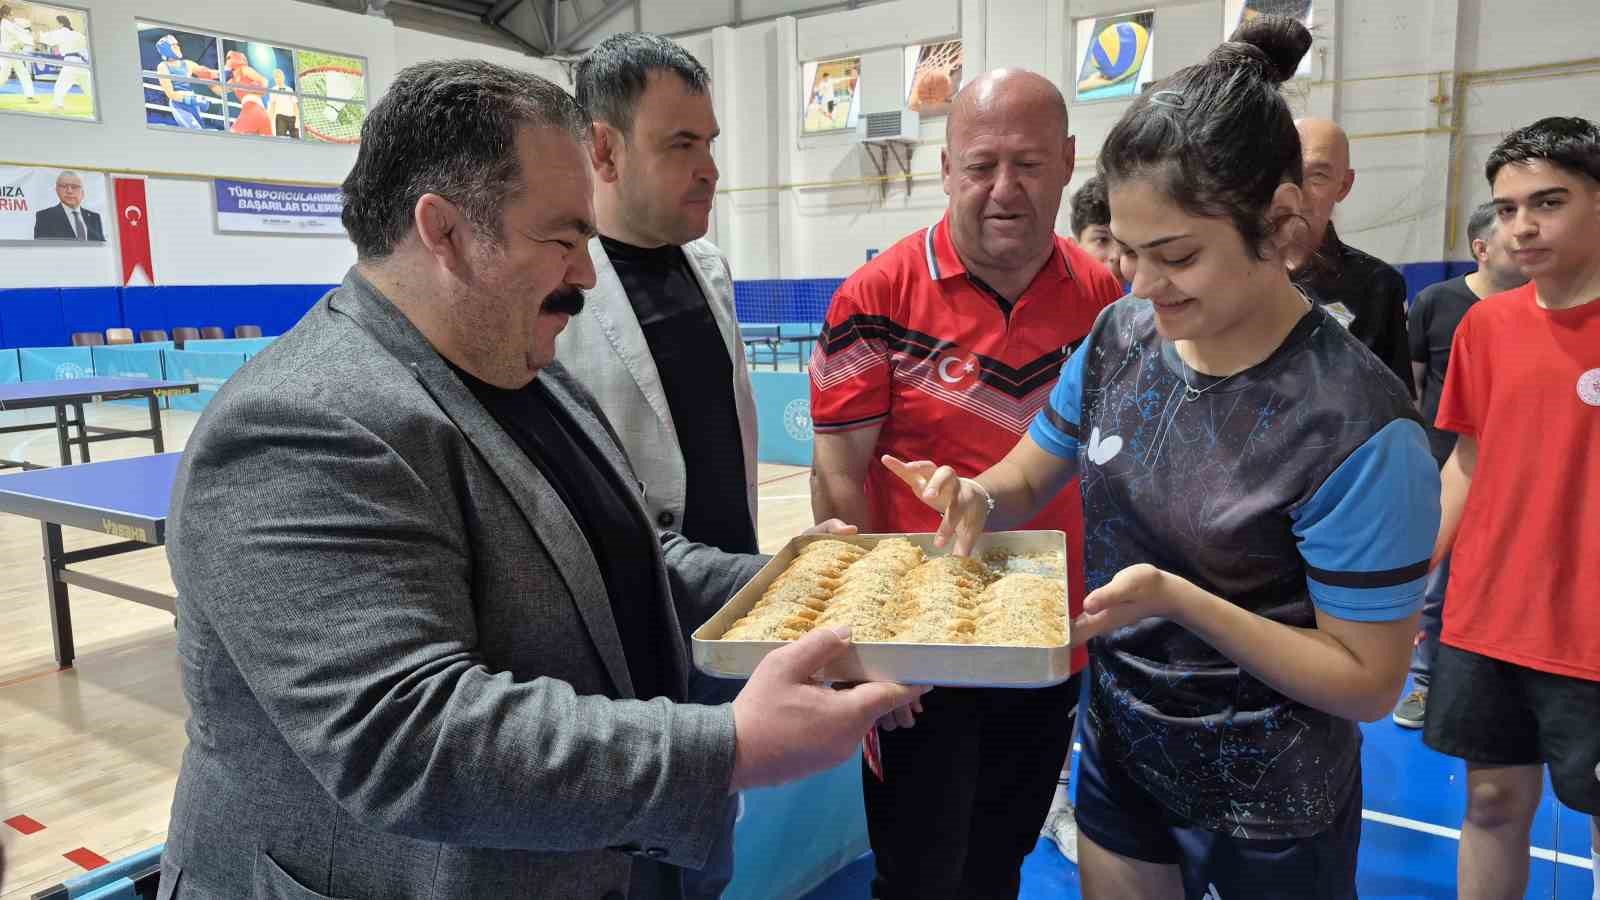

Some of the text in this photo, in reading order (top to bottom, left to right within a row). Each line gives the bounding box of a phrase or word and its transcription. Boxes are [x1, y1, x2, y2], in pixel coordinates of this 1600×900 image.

[0, 186, 24, 197] IZA
[227, 186, 254, 198] TÜM
[238, 199, 300, 212] BAŞARILAR
